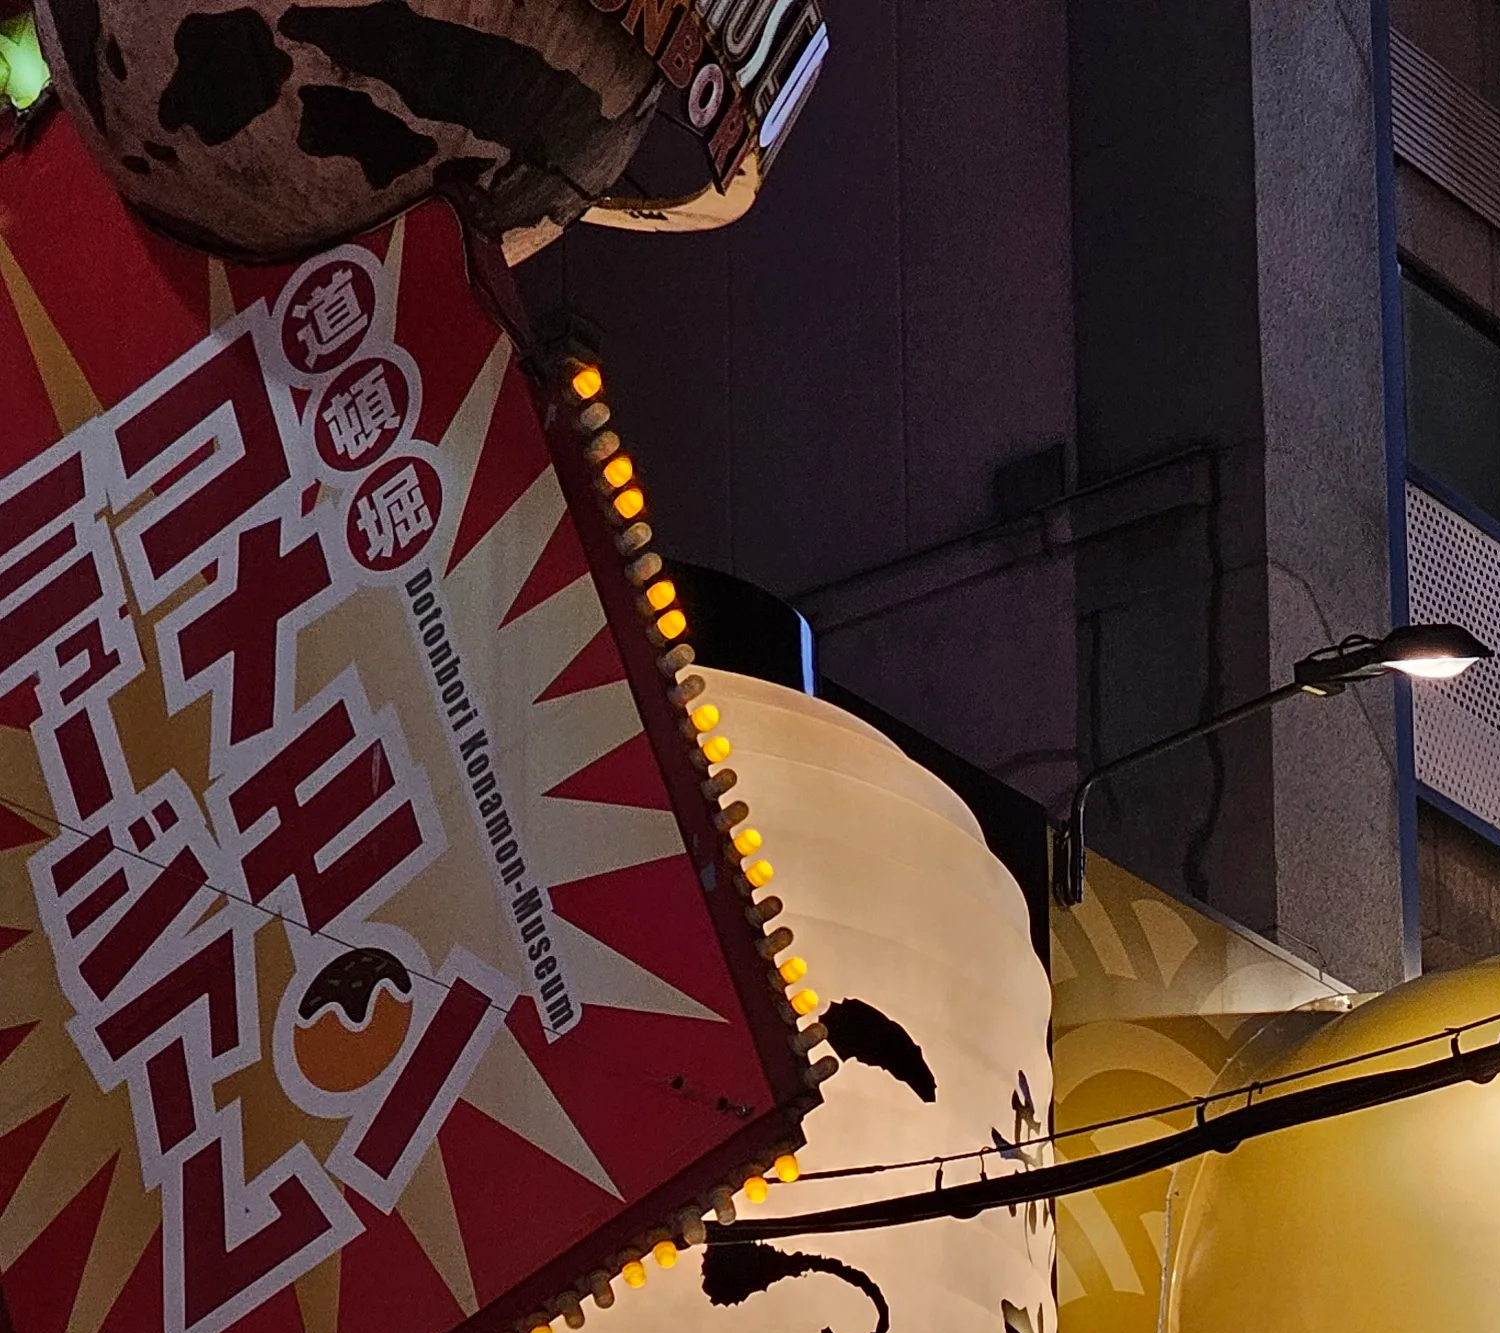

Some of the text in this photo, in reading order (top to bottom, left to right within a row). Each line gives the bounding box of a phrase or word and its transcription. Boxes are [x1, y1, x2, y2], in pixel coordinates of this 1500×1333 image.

[296, 268, 434, 562] 道頓堀
[405, 566, 577, 1031] Dotonbori Konamon-Museum
